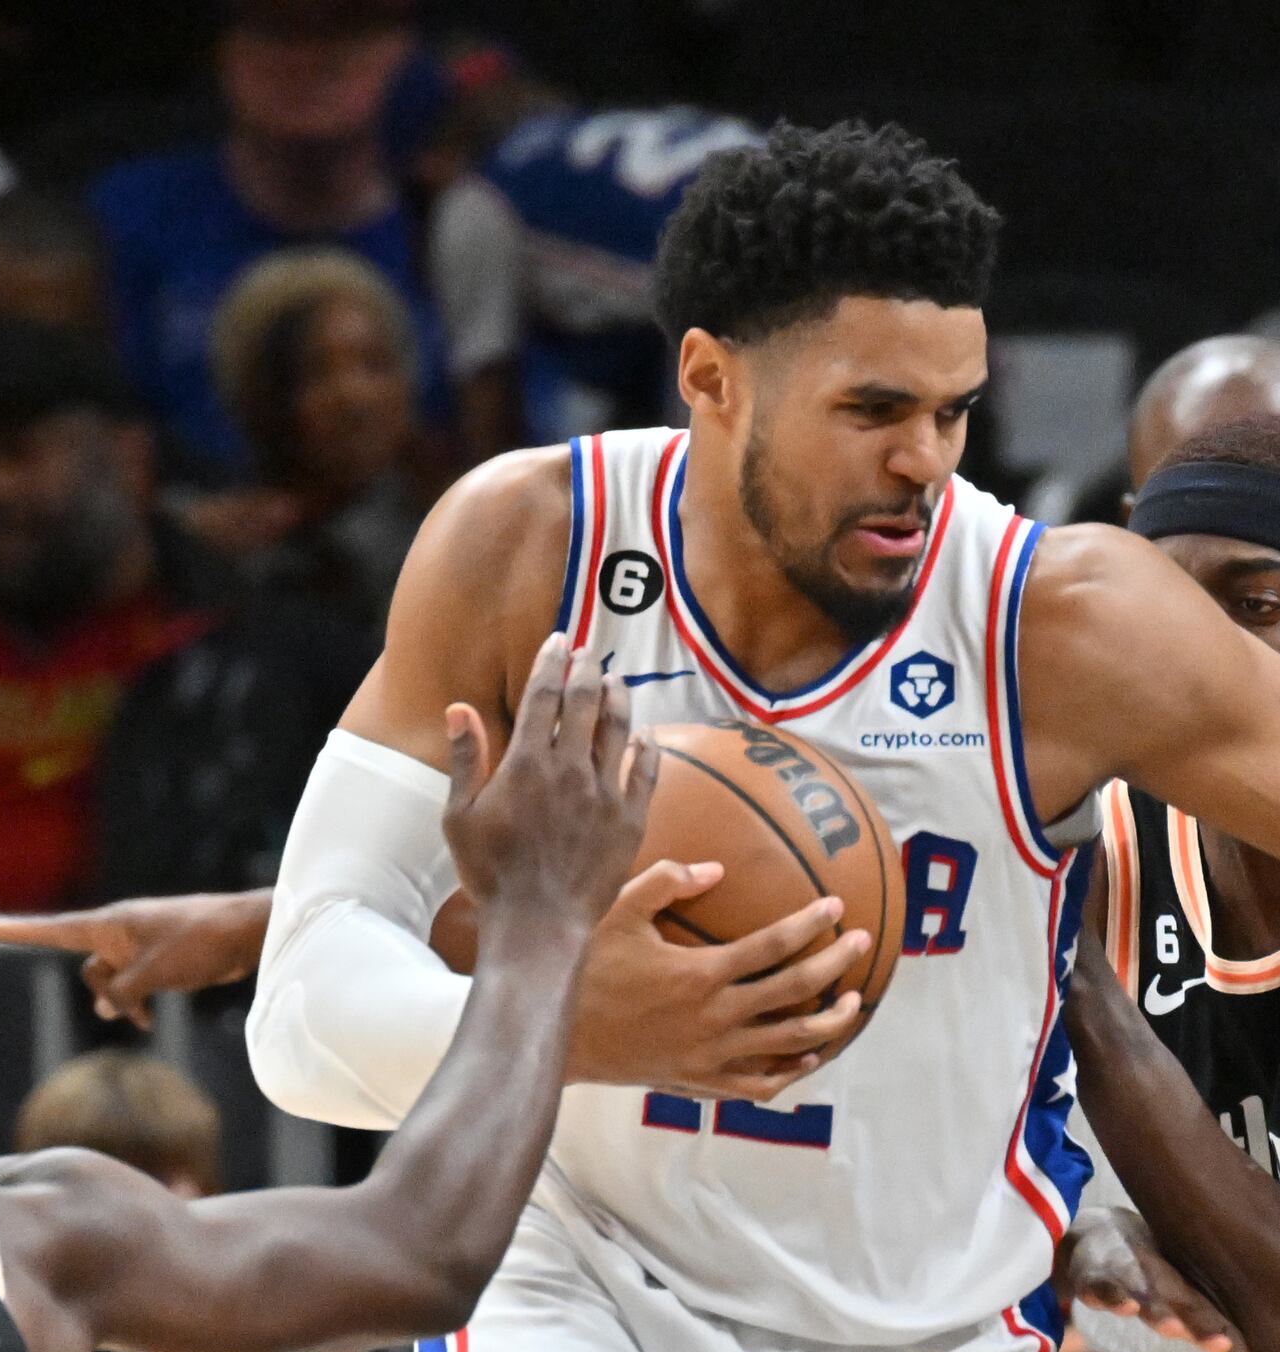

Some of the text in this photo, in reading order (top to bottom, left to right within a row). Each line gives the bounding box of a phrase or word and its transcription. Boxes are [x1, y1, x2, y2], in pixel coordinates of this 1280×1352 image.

[608, 558, 650, 609] 6
[860, 730, 986, 750] crypto.com
[1155, 913, 1181, 965] 6
